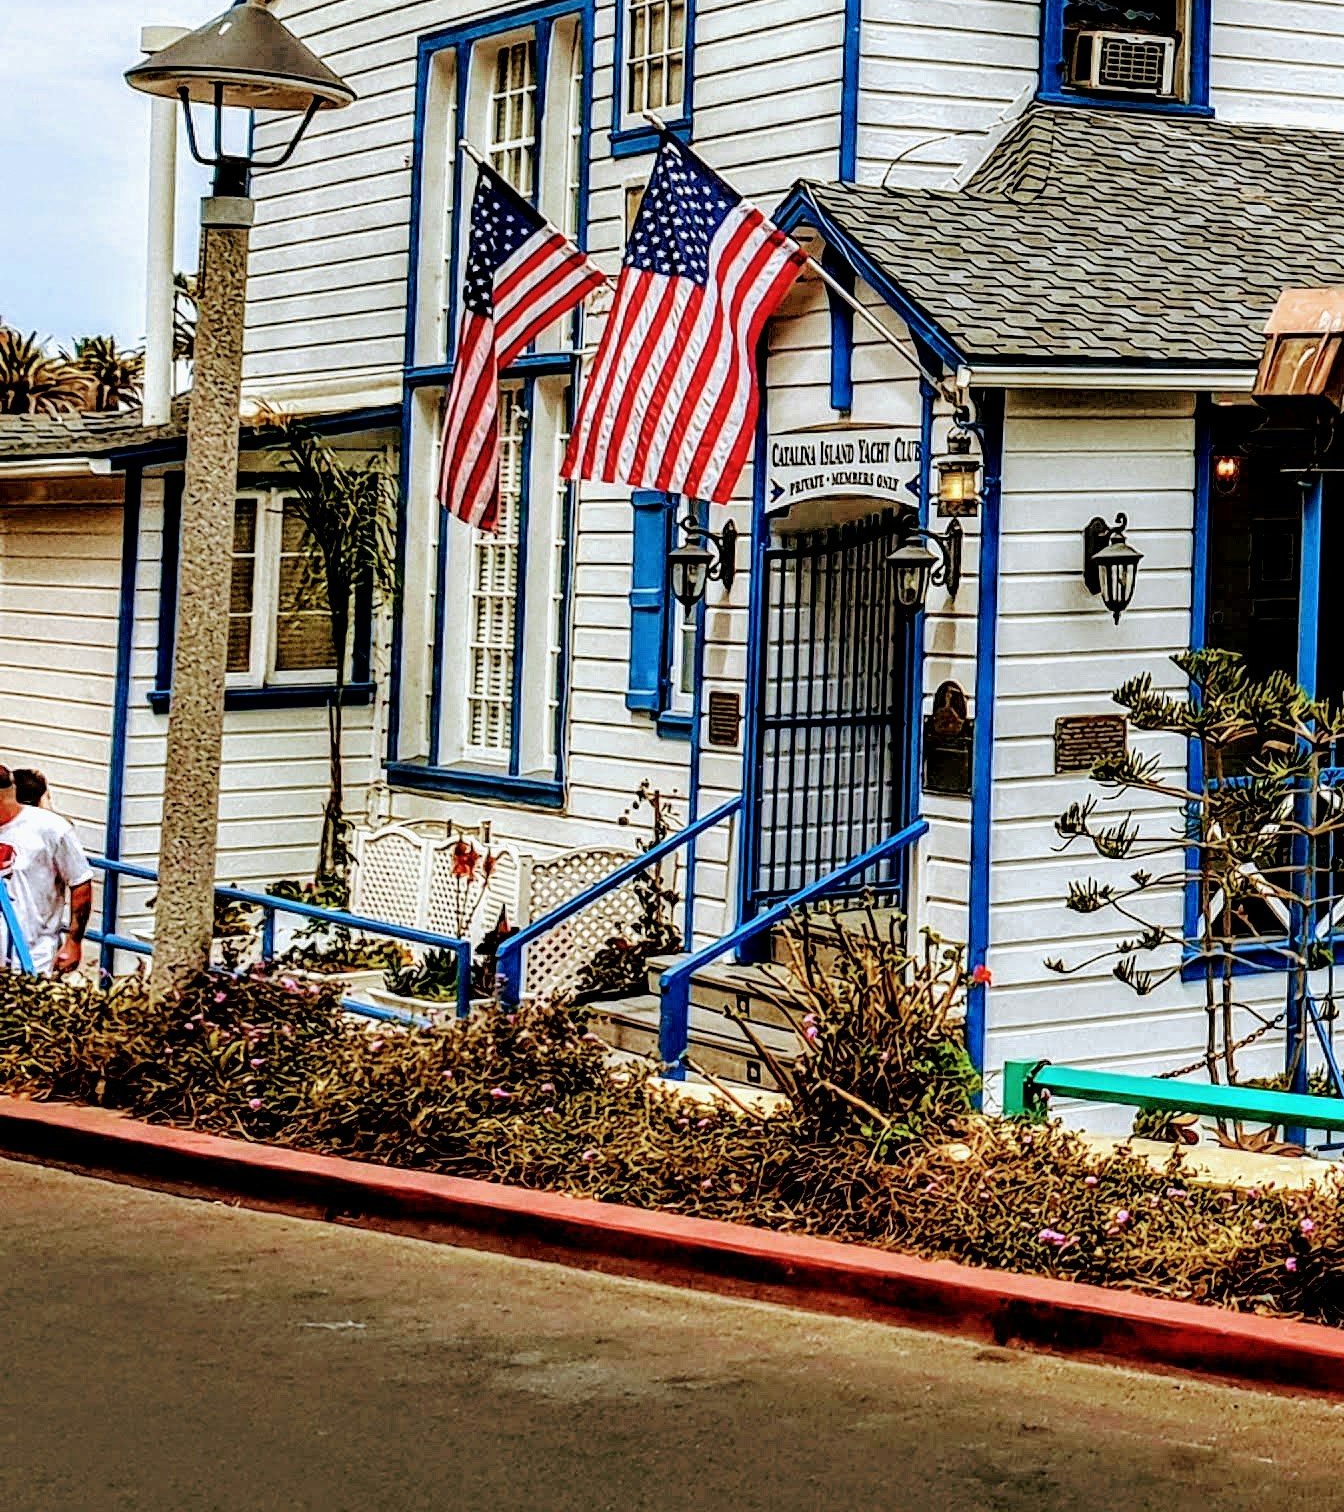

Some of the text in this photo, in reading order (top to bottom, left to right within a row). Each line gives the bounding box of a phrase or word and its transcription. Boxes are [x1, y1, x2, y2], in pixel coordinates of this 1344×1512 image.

[772, 436, 922, 468] CATALINA ISLAND YACHT CLUB
[790, 471, 900, 496] PRIVATE MEMBERS ONLY
